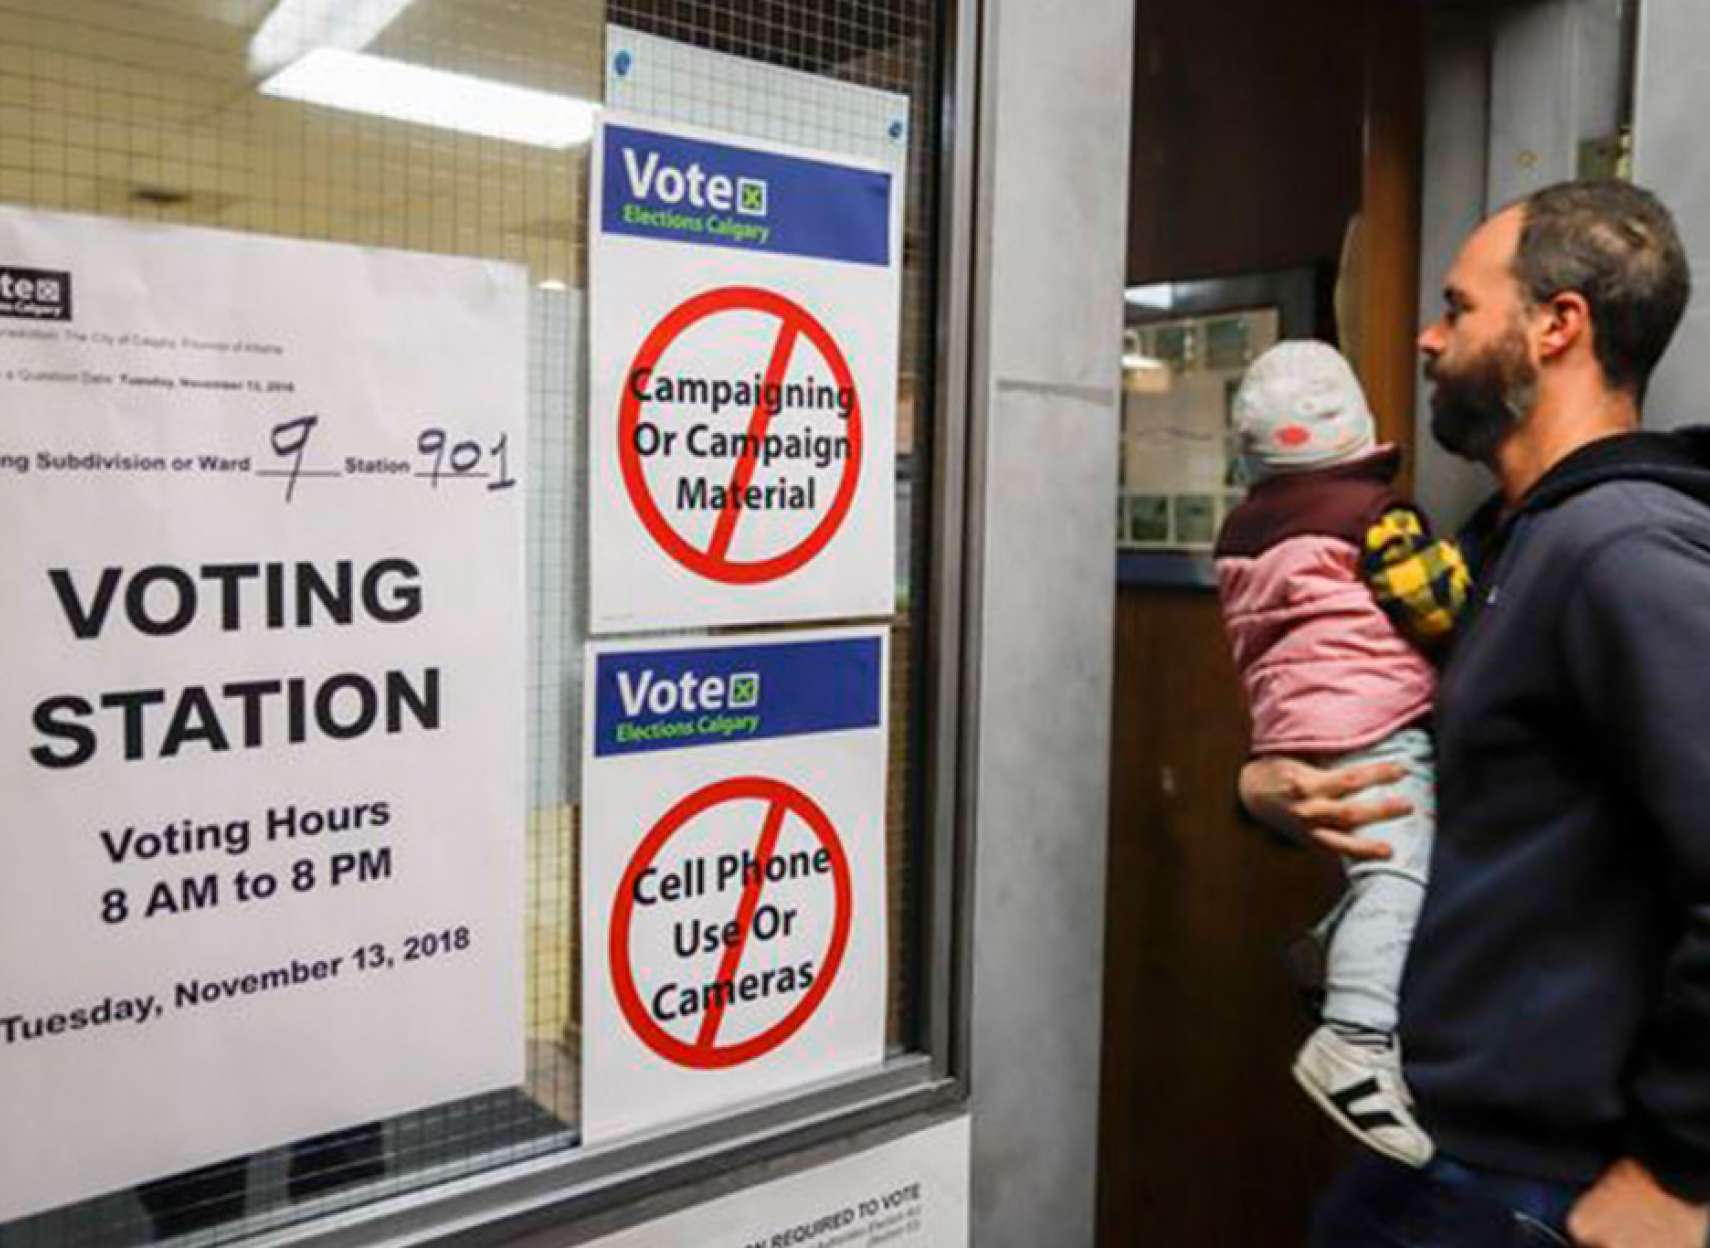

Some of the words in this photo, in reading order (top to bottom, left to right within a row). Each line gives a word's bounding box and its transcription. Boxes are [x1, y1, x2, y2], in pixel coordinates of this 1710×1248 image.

[622, 147, 735, 211] Vote
[622, 203, 702, 231] Elections
[707, 215, 770, 244] Calgary
[629, 367, 854, 420] Campaigning
[37, 451, 166, 471] Subdivision
[171, 458, 192, 471] or
[199, 456, 252, 473] Ward
[269, 415, 318, 503] 9
[345, 456, 411, 475] Station
[416, 429, 516, 491] 901
[633, 421, 677, 457] Or
[686, 424, 851, 468] Campaign
[676, 476, 816, 510] Material
[48, 558, 423, 640] VOTING
[30, 667, 440, 769] STATION
[617, 670, 724, 717] Vote
[615, 721, 694, 742] Elections
[698, 714, 760, 735] Calgary
[101, 820, 250, 864] Voting
[266, 801, 391, 841] Hours
[101, 890, 129, 924] 8
[144, 874, 218, 918] AM
[234, 871, 277, 902] to
[291, 860, 316, 892] 8
[330, 848, 392, 886] PM
[633, 857, 705, 905] Cell
[717, 847, 832, 892] Phone
[674, 918, 741, 957] Use
[752, 904, 797, 941] Or
[0, 994, 163, 1044] Tuesday,
[174, 957, 343, 1008] November
[352, 943, 394, 971] 13,
[403, 926, 470, 960] 2018
[652, 961, 814, 1021] Cameras
[771, 1208, 855, 1248] REQUIRED
[858, 1198, 879, 1218] TO
[882, 1183, 920, 1209] VOTE
